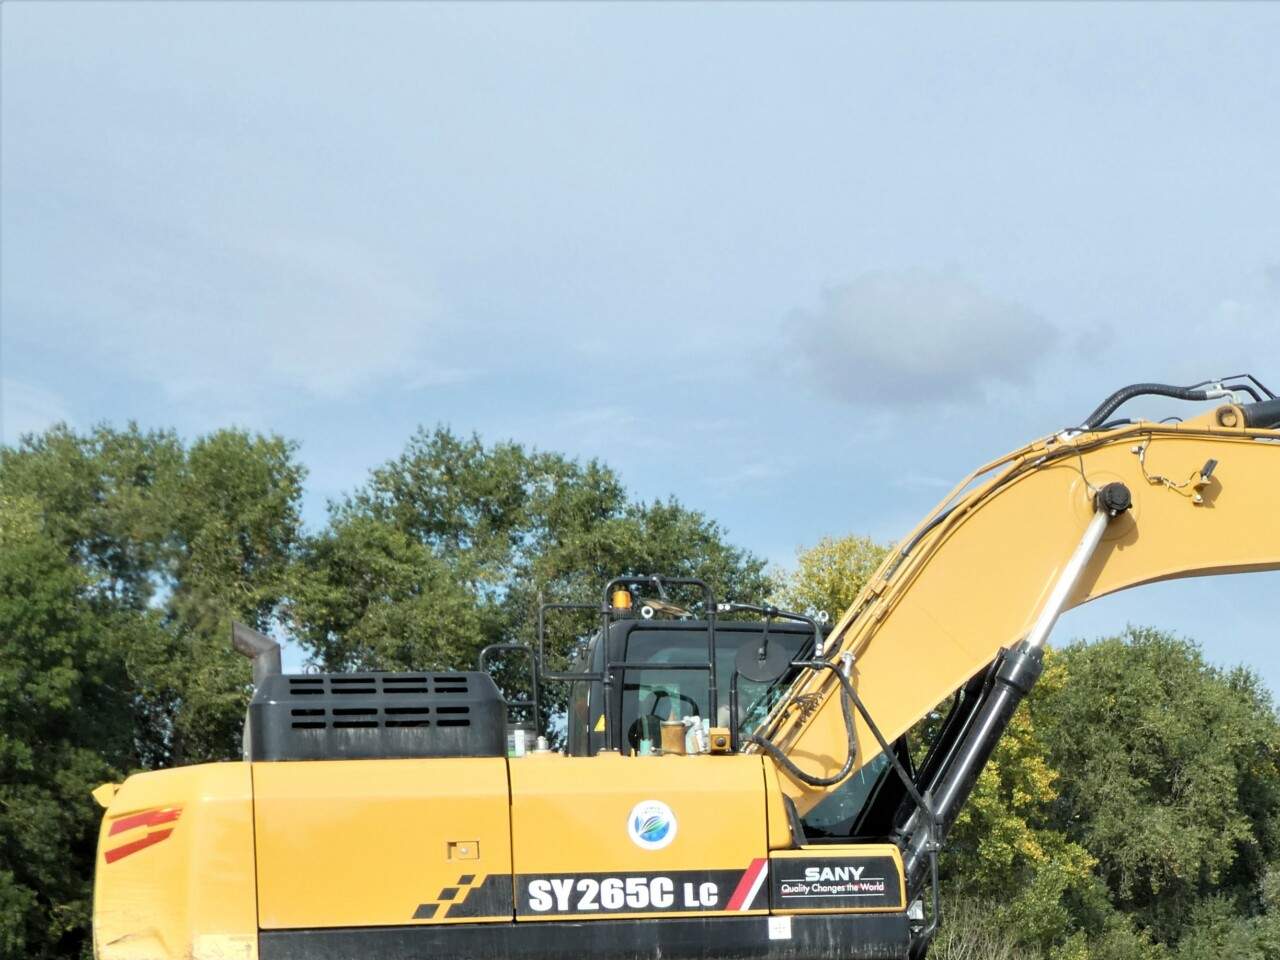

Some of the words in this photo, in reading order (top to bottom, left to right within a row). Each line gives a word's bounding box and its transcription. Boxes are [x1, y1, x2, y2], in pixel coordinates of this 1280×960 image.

[804, 866, 865, 881] SANY
[528, 877, 674, 911] SY265C
[684, 882, 719, 907] LC
[781, 884, 810, 895] Quality
[811, 883, 845, 894] Changes
[846, 882, 859, 892] the
[860, 881, 885, 892] World
